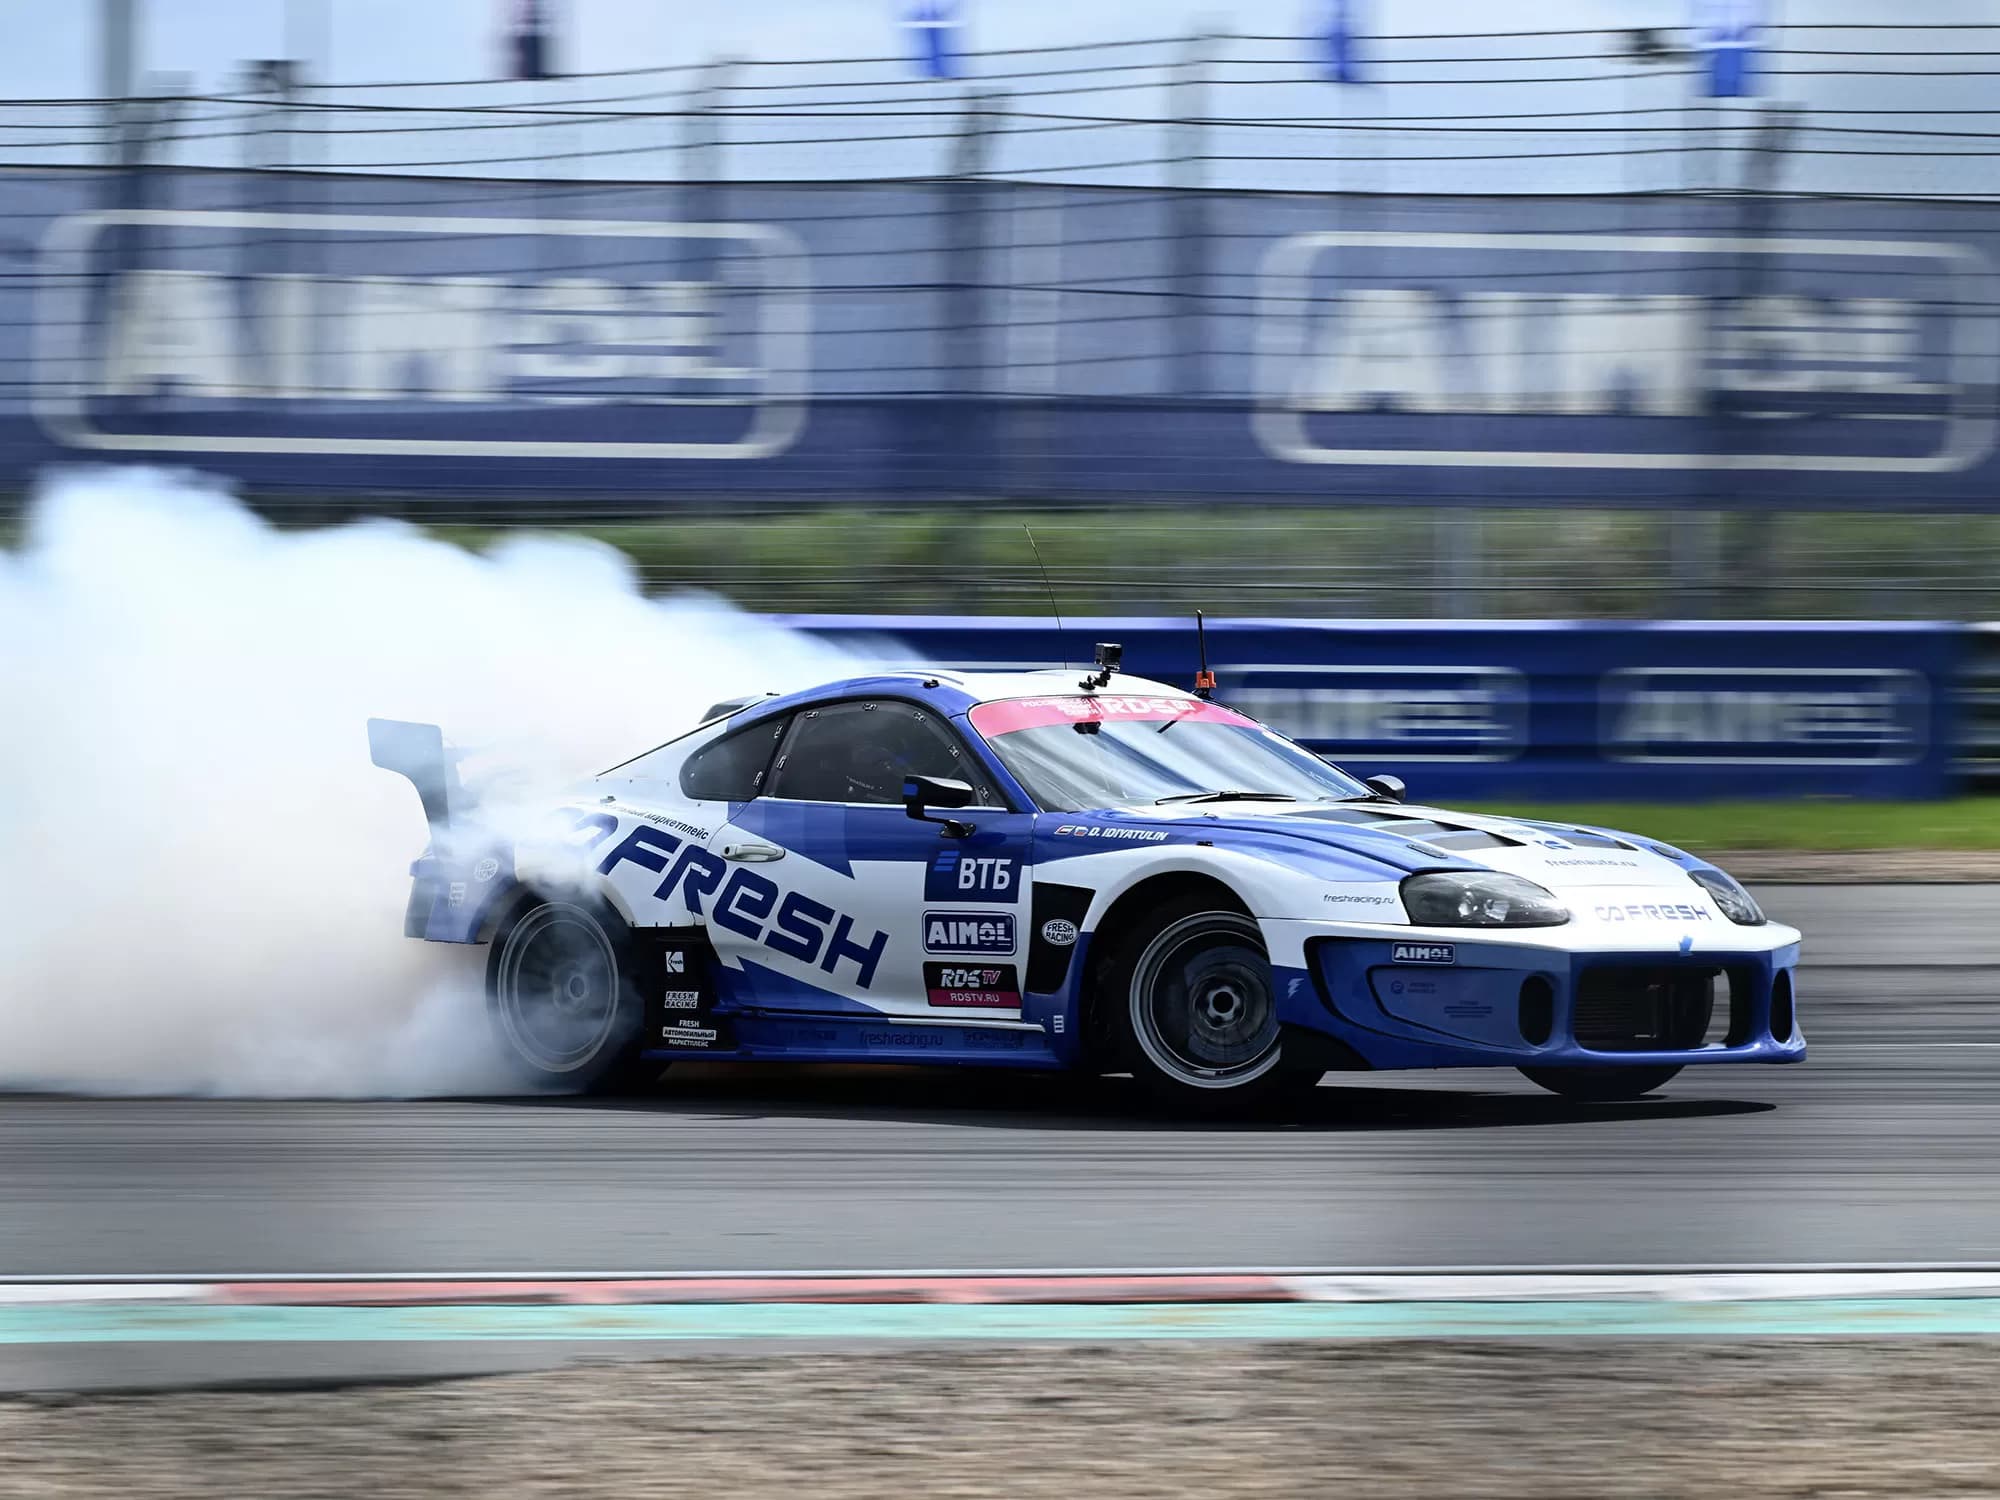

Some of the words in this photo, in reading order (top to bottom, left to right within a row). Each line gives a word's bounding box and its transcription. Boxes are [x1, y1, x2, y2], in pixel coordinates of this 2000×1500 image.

[1087, 828, 1100, 838] D.
[1101, 829, 1168, 841] IDIYATULIN
[958, 857, 1012, 890] ВТБ
[1323, 893, 1395, 905] freshracing.ru
[927, 920, 1012, 946] AIMOL
[1047, 922, 1074, 934] FRESH
[1046, 931, 1074, 942] RACING
[666, 992, 696, 1000] FRESH
[950, 991, 1000, 1004] RDSTV.RU
[665, 1000, 697, 1008] RACING
[679, 1019, 700, 1028] FRESH
[860, 1031, 943, 1049] freshracing.ru
